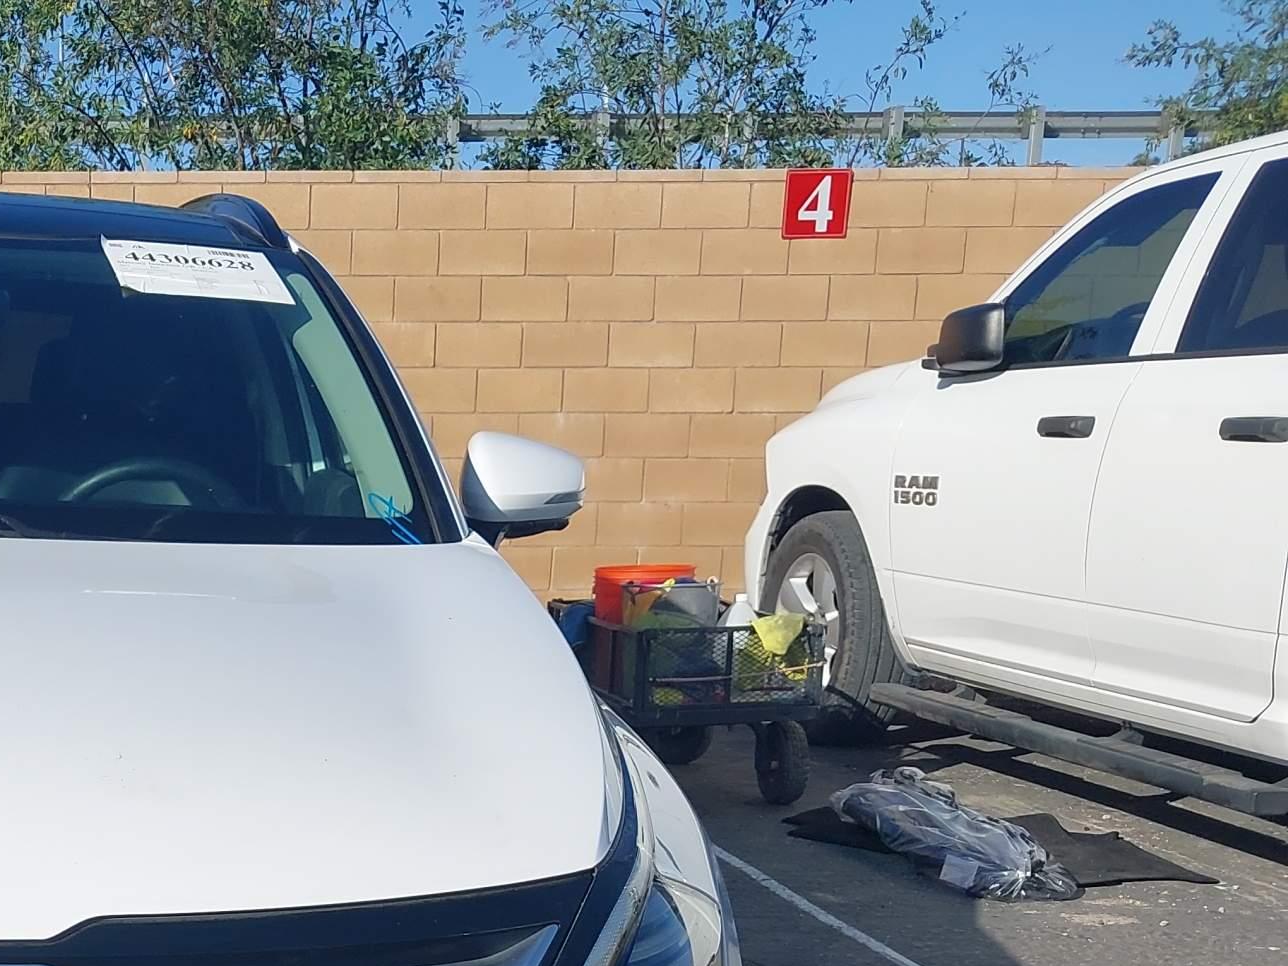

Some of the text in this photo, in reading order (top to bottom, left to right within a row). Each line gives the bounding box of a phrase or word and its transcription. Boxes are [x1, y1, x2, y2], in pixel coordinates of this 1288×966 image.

[798, 175, 833, 232] 4
[125, 251, 255, 271] 44306628
[894, 475, 939, 489] RAM
[894, 490, 938, 506] 1500
